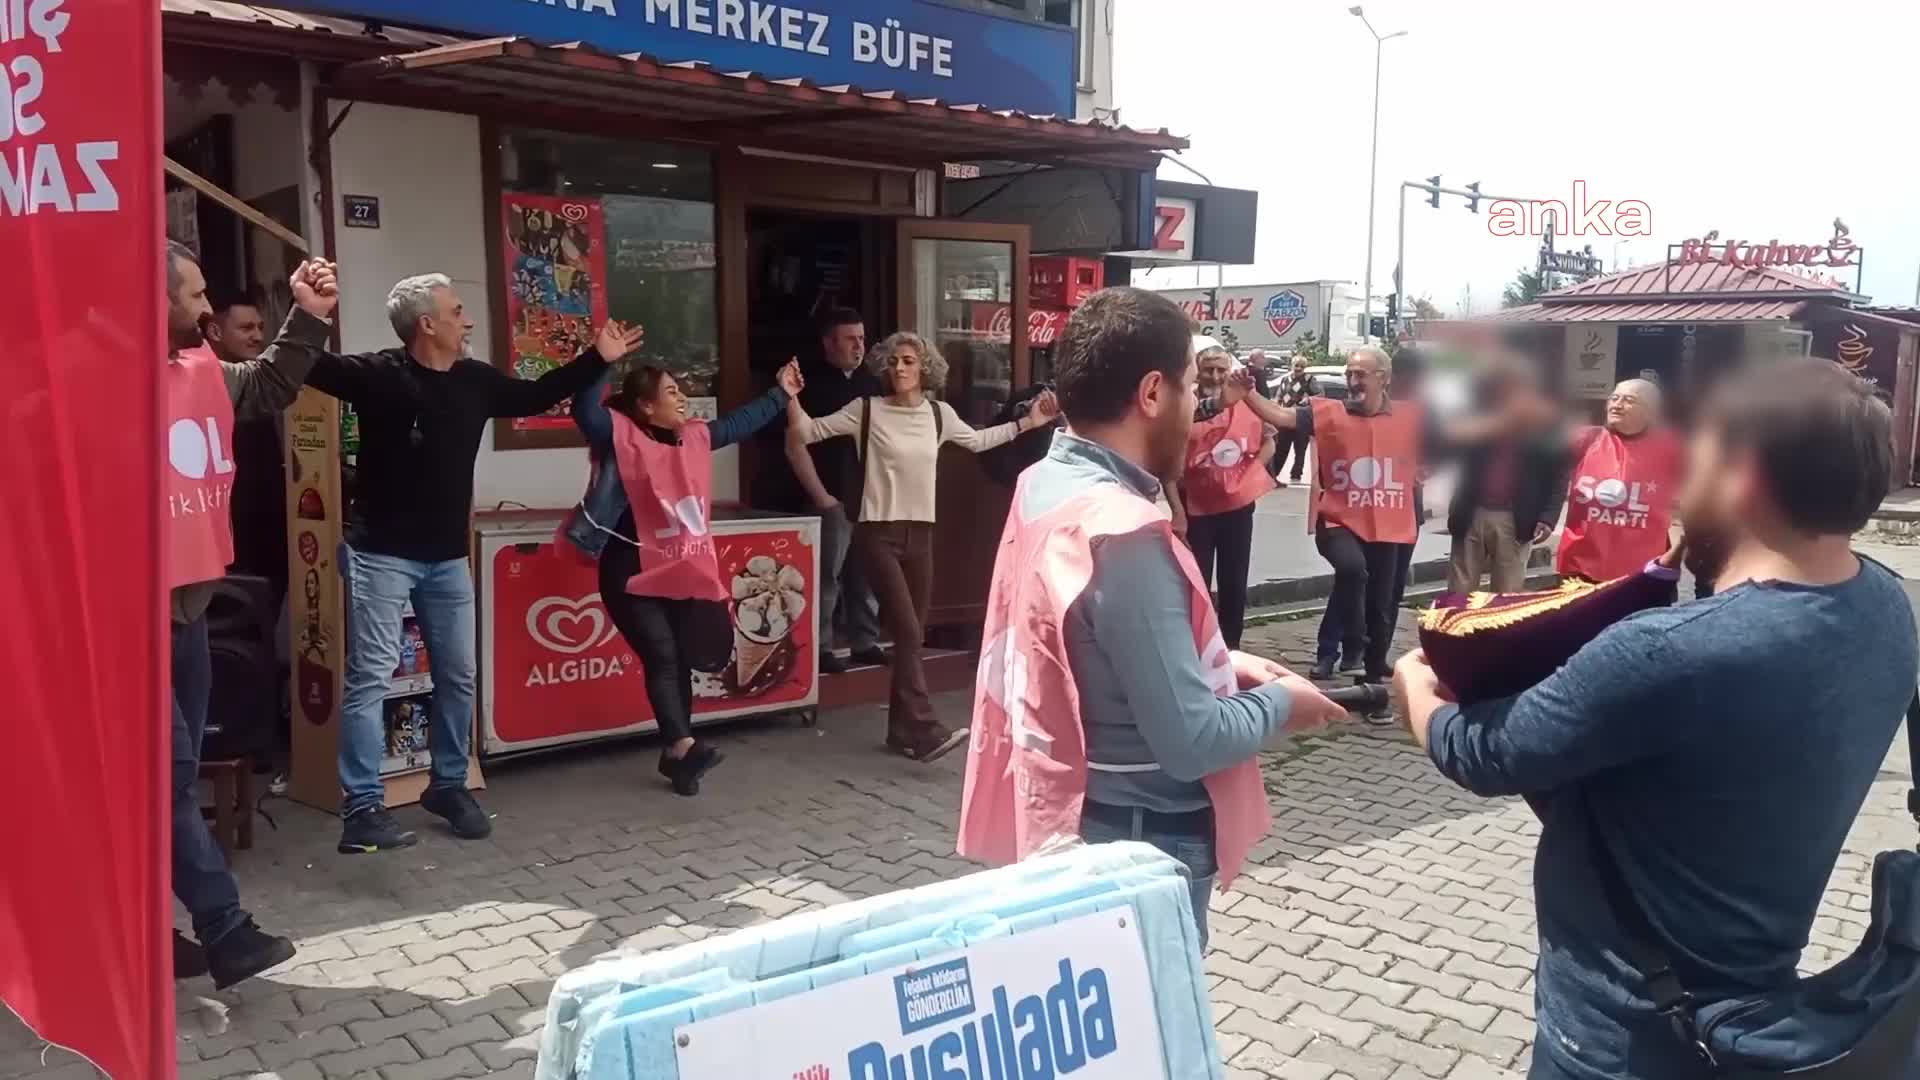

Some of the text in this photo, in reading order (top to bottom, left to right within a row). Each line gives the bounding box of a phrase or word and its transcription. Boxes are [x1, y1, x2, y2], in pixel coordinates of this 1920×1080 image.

[644, 0, 953, 77] MERKEZ BÜFE
[354, 205, 369, 218] 27
[1331, 457, 1403, 491] SOL
[1574, 475, 1650, 508] SOL
